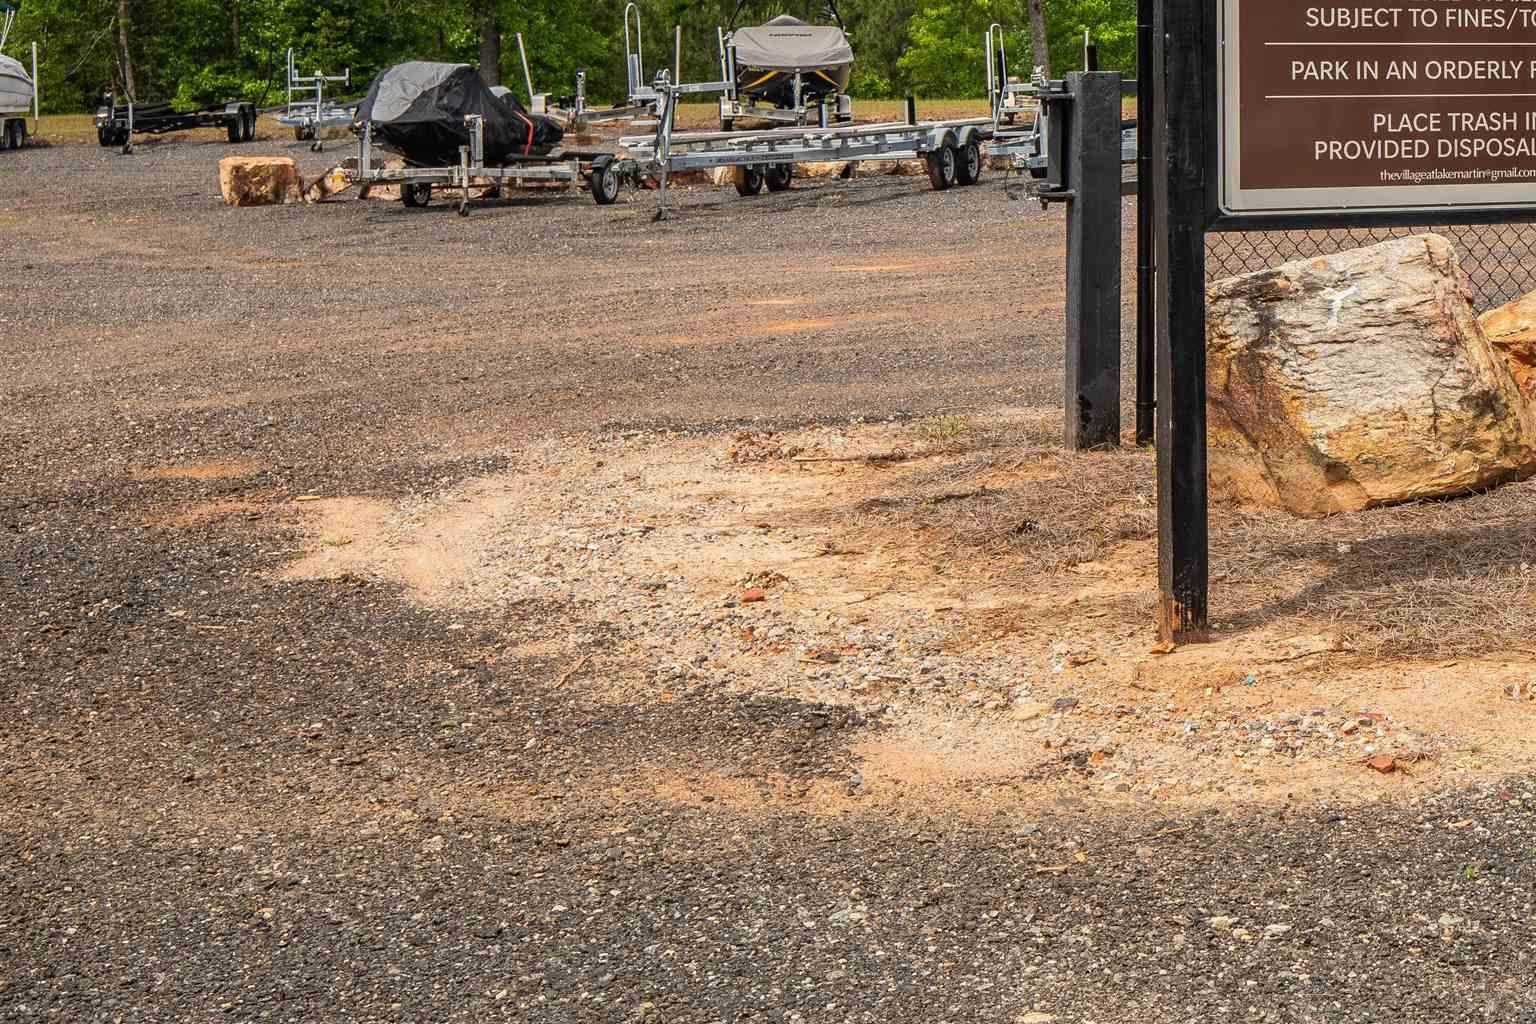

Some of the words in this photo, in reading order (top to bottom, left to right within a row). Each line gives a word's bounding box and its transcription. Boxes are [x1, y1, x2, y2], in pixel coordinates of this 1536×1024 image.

[1306, 8, 1402, 28] SUBJECT
[1408, 9, 1438, 28] TO
[1291, 61, 1349, 80] PARK
[1356, 61, 1380, 80] IN
[1386, 61, 1417, 80] AN
[1424, 61, 1522, 79] ORDERLY
[1373, 113, 1441, 132] PLACE
[1448, 113, 1518, 131] TRASH
[1314, 140, 1430, 160] PROVIDED
